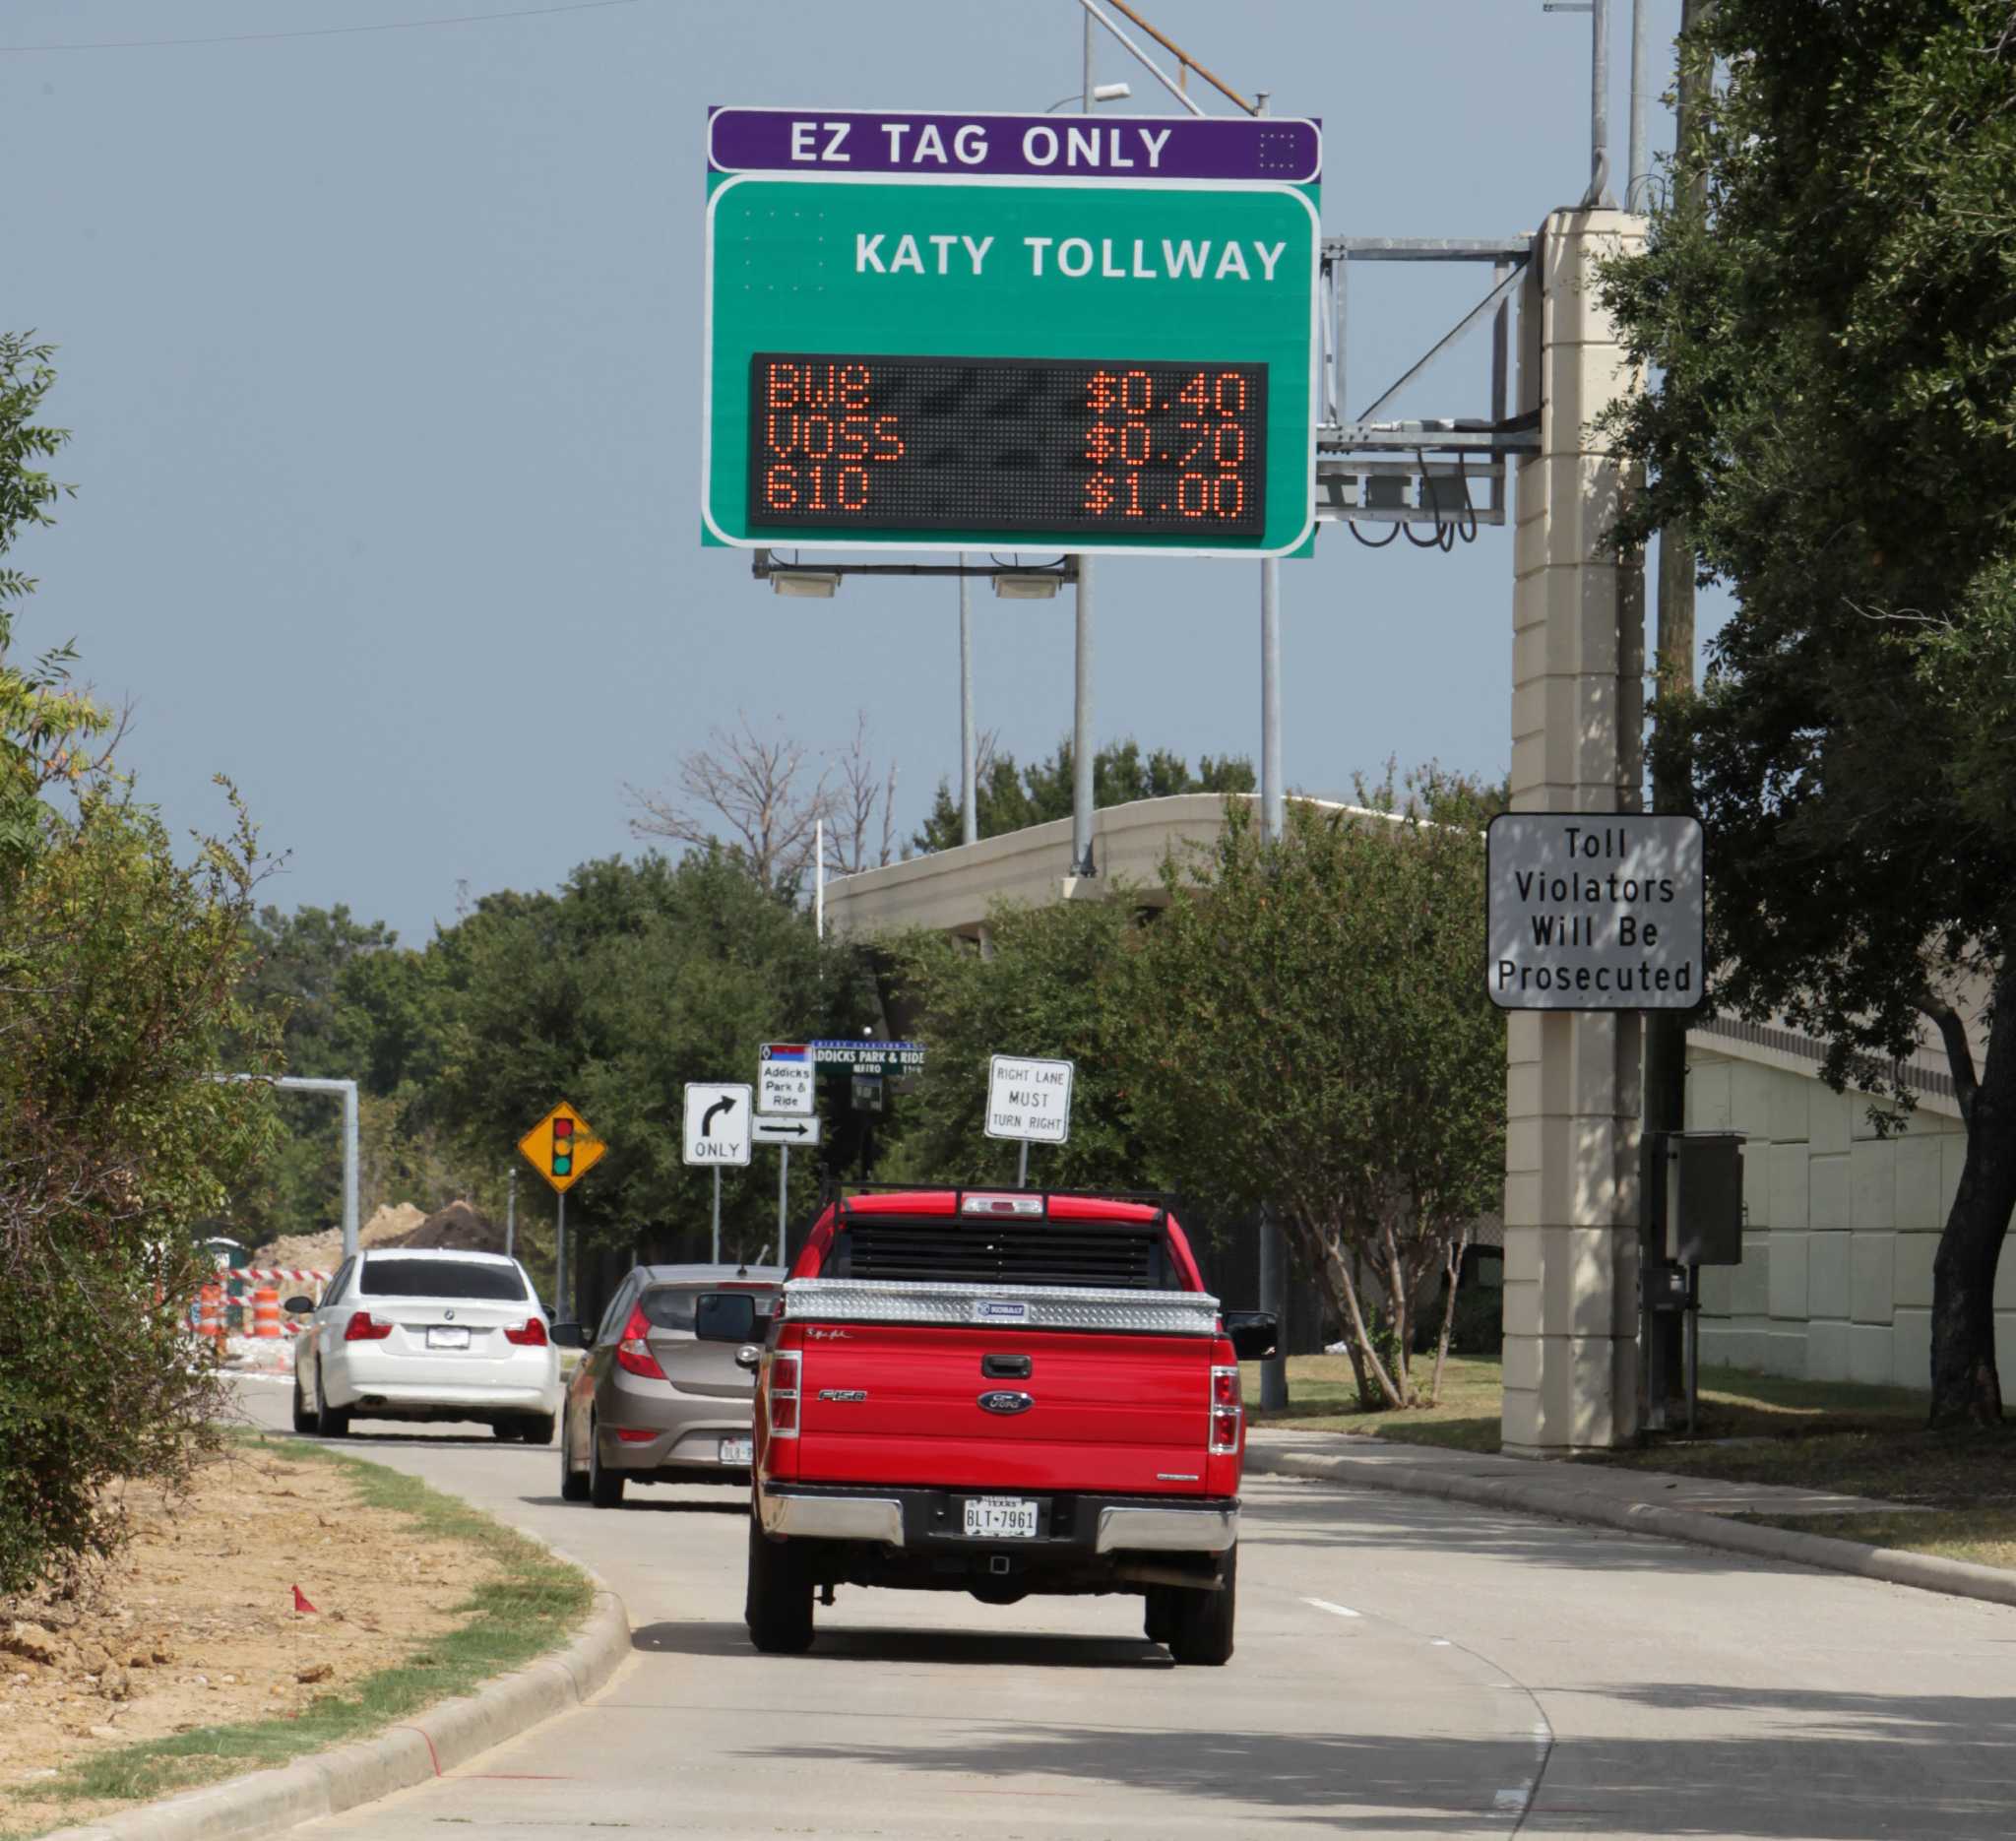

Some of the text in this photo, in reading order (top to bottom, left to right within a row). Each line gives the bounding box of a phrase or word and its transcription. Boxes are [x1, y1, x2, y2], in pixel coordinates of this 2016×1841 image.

[790, 121, 1172, 168] EZ TAG ONLY
[855, 233, 1288, 281] KATY TOLLWAY
[1086, 370, 1245, 416] $0.40
[768, 414, 1244, 468] VOSS $0.70
[768, 465, 1243, 517] 610 $1.00
[1564, 827, 1625, 858] Toll
[1515, 870, 1674, 903] Violators
[1532, 915, 1658, 947] Will Be
[1498, 959, 1691, 991] Prosecuted
[859, 1050, 886, 1063] PARK
[900, 1051, 924, 1064] RIDE
[764, 1066, 810, 1080] Addicks
[765, 1081, 792, 1093] Park
[996, 1066, 1064, 1086] RIGHT LANE
[773, 1095, 798, 1107] Ride
[1009, 1090, 1048, 1108] MUST
[993, 1113, 1062, 1130] TURN RIGHT
[694, 1141, 740, 1158] ONLY
